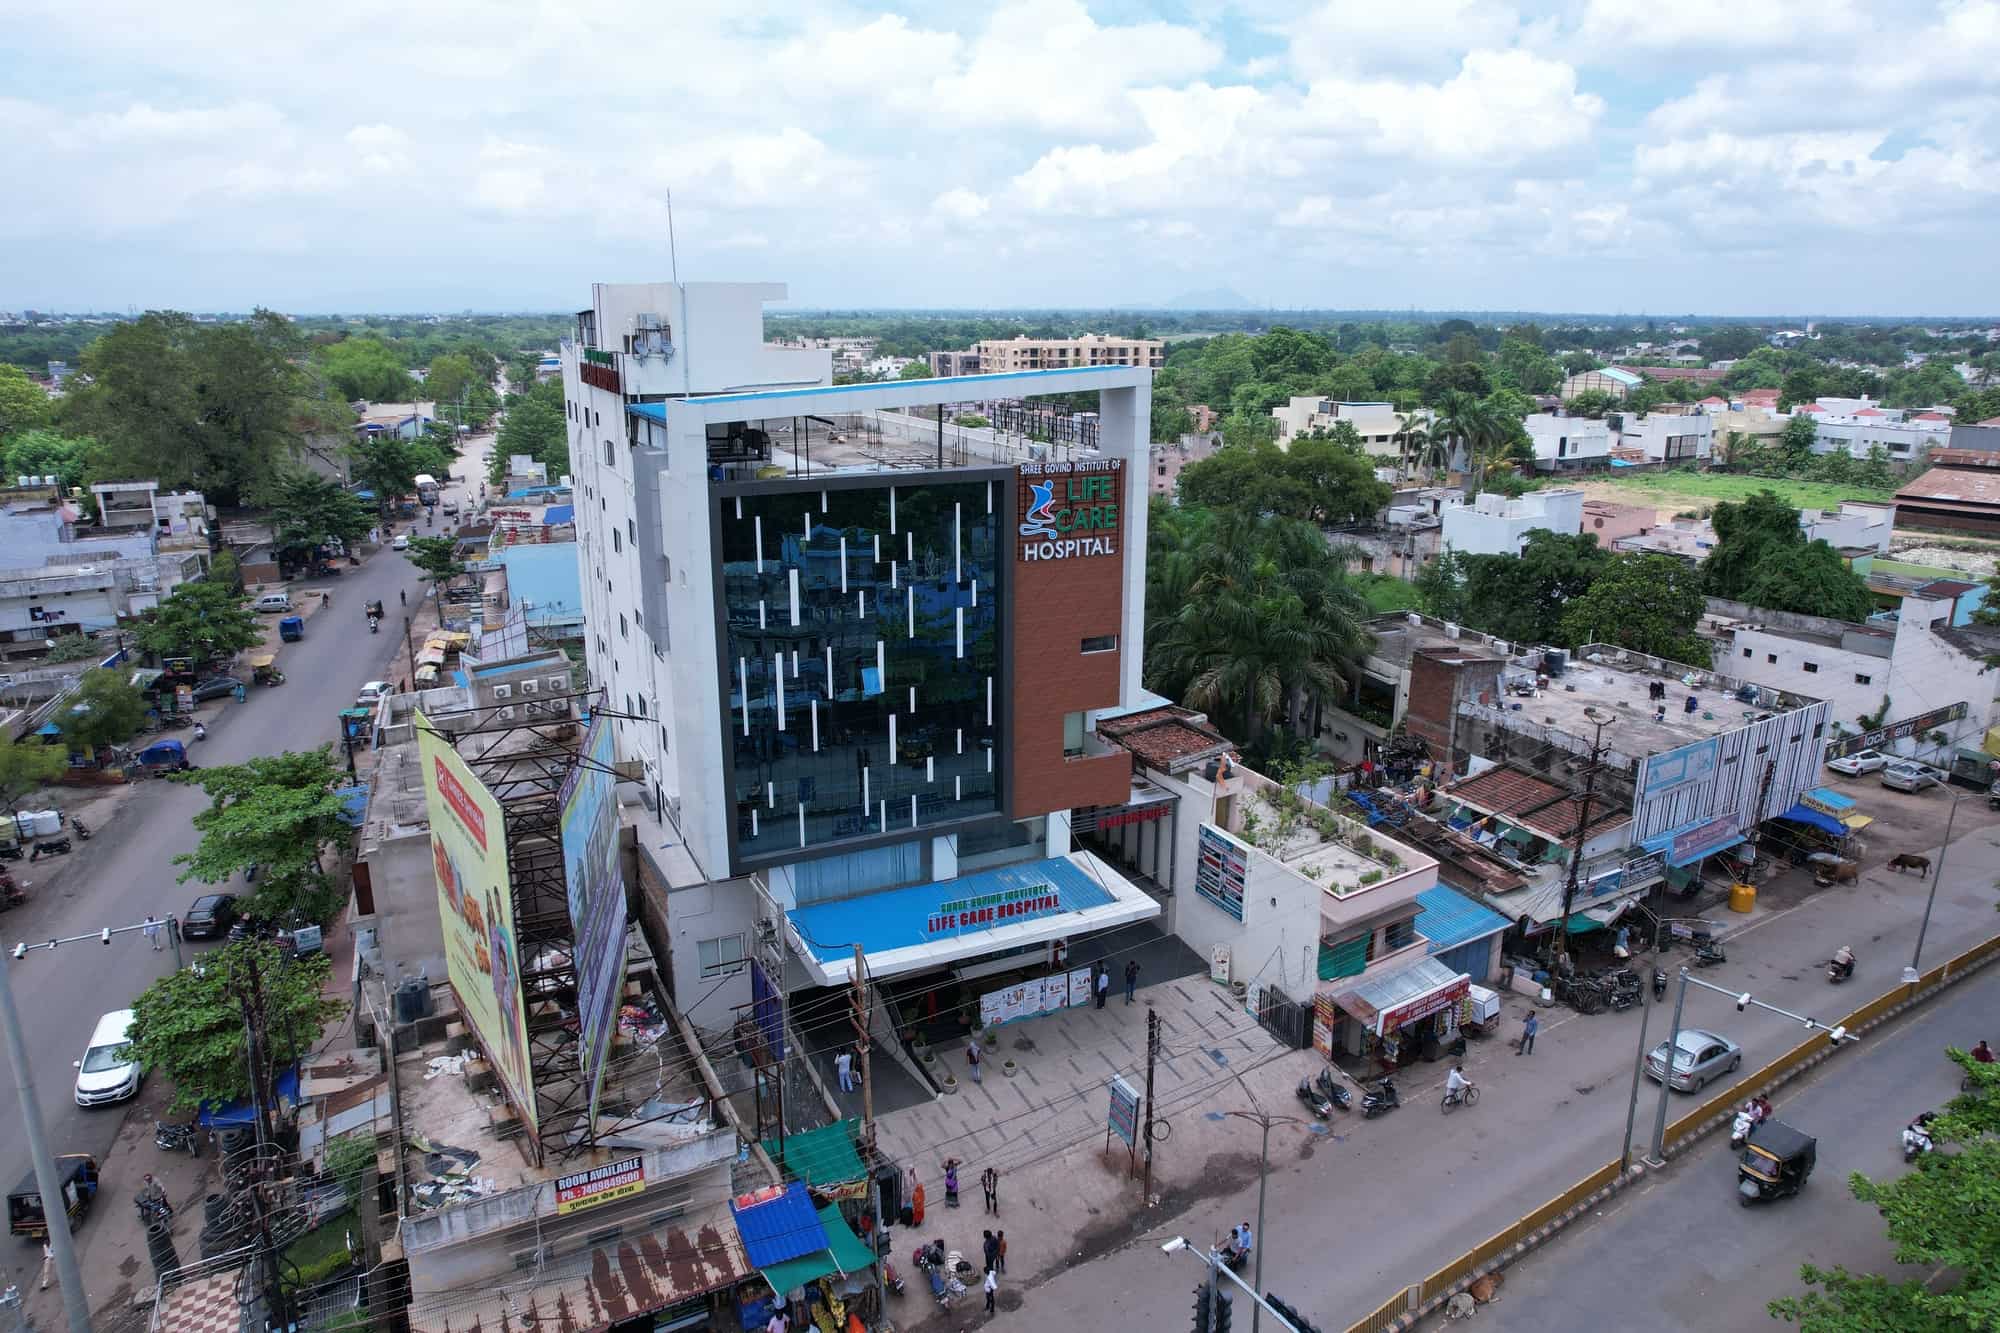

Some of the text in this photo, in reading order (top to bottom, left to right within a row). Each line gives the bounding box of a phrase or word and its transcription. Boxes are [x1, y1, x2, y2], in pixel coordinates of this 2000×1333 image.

[1020, 459, 1121, 475] SHREE GOVIND INSTITUTE OF
[1068, 476, 1112, 501] LIFE
[1055, 504, 1119, 533] CARE
[1024, 536, 1115, 561] HOSPITAL
[928, 894, 1060, 933] LIFE CARE HOSPITAL
[559, 1158, 640, 1190] ROOM AVAILABLE
